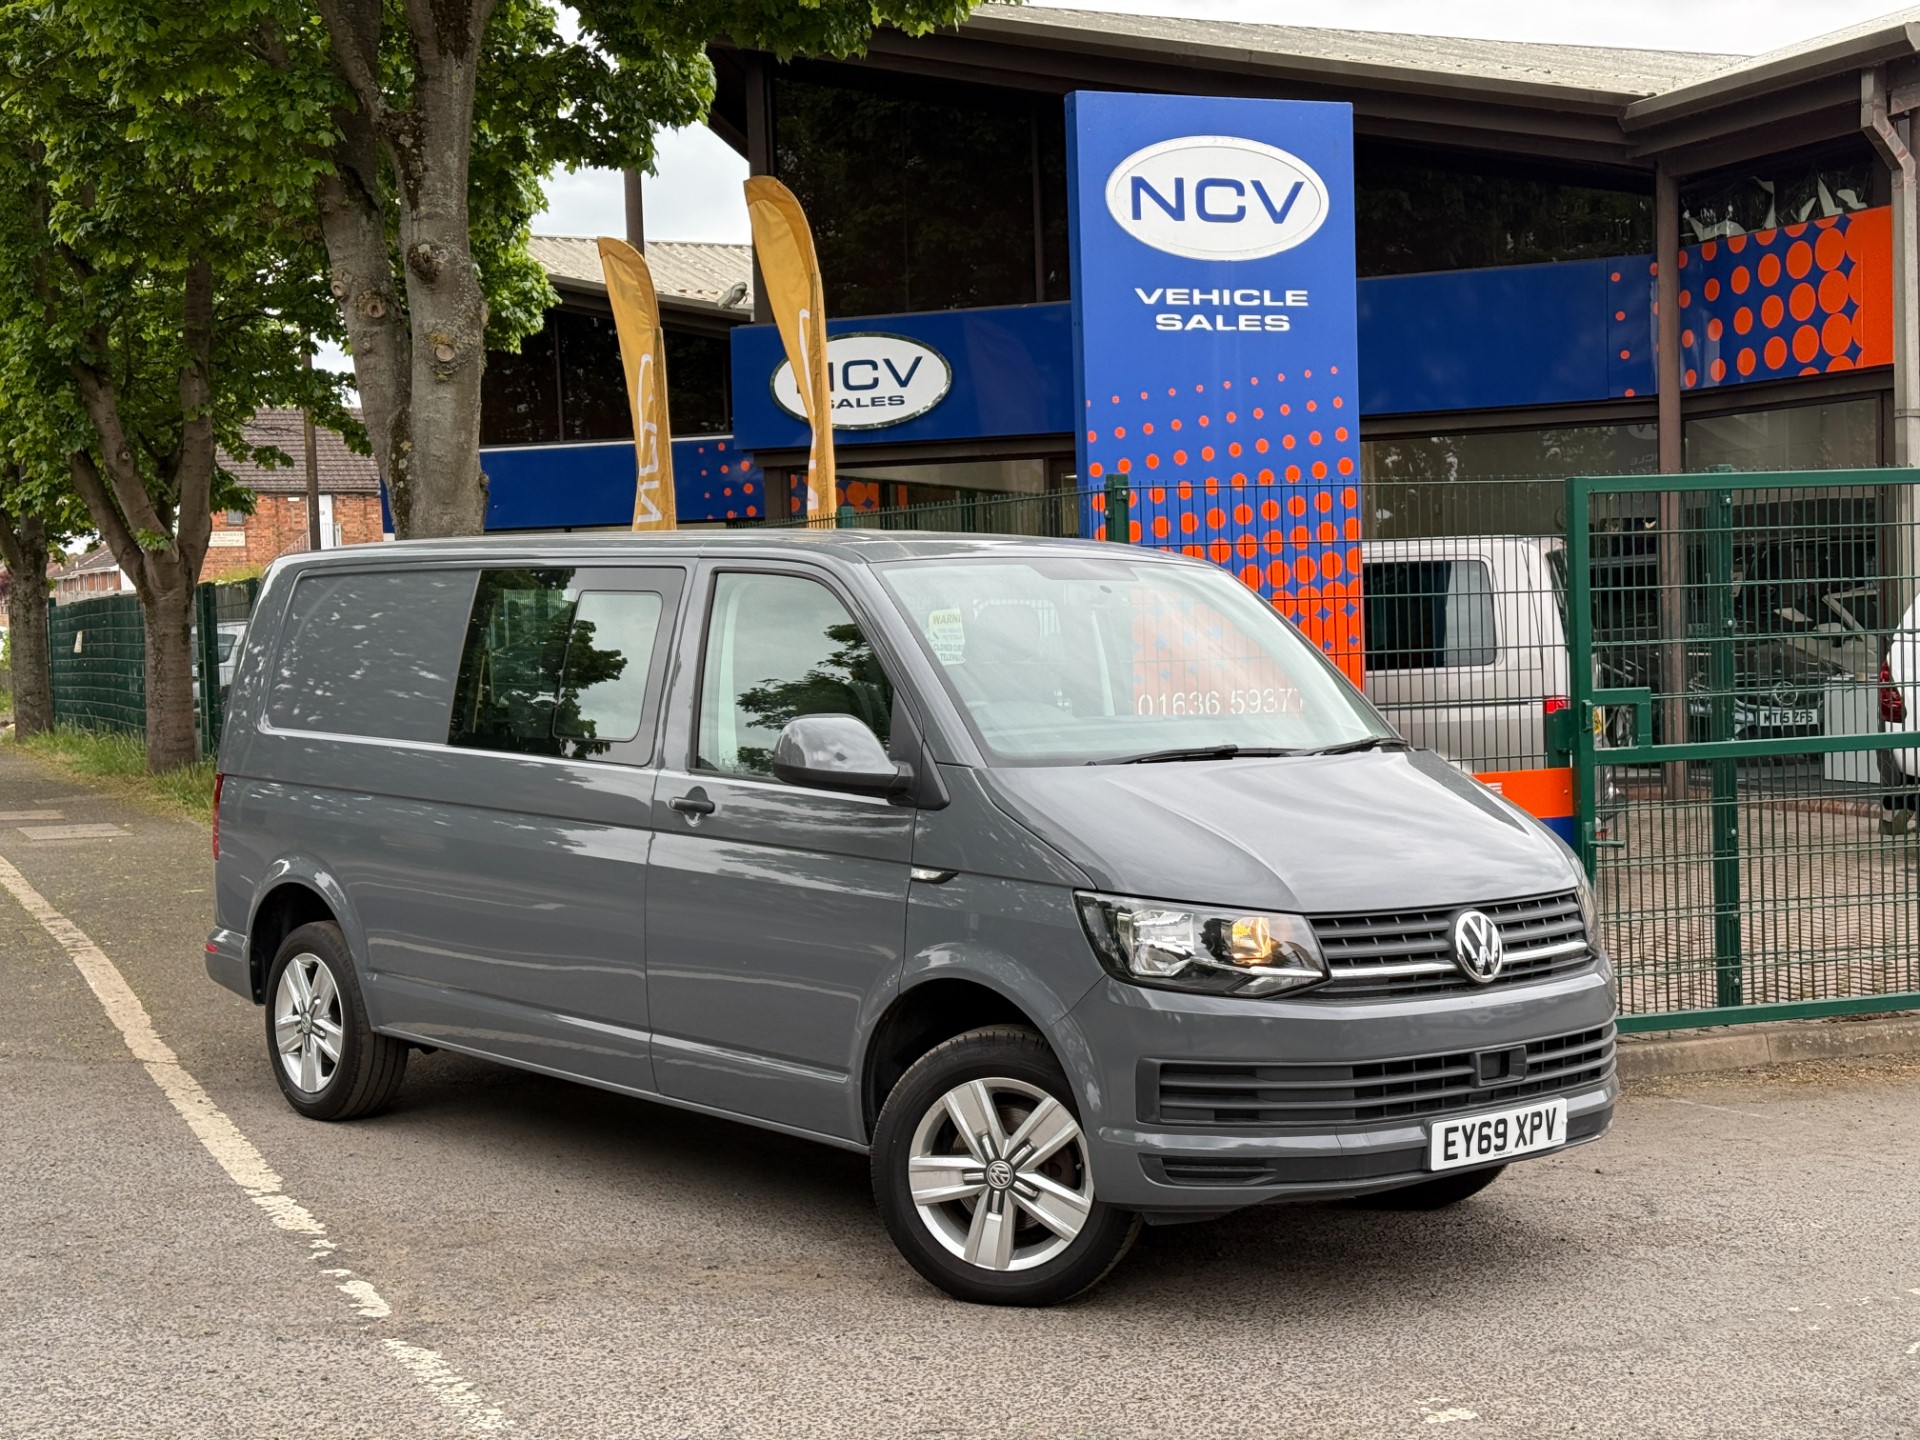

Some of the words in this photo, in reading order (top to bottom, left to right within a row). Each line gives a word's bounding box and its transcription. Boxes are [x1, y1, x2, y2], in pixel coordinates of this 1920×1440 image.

[1131, 176, 1305, 224] NCV
[1135, 288, 1309, 306] VEHICLE
[1156, 314, 1290, 331] SALES
[1138, 691, 1221, 715] 01636
[1444, 1118, 1508, 1161] EY69
[1515, 1107, 1557, 1148] XPV
